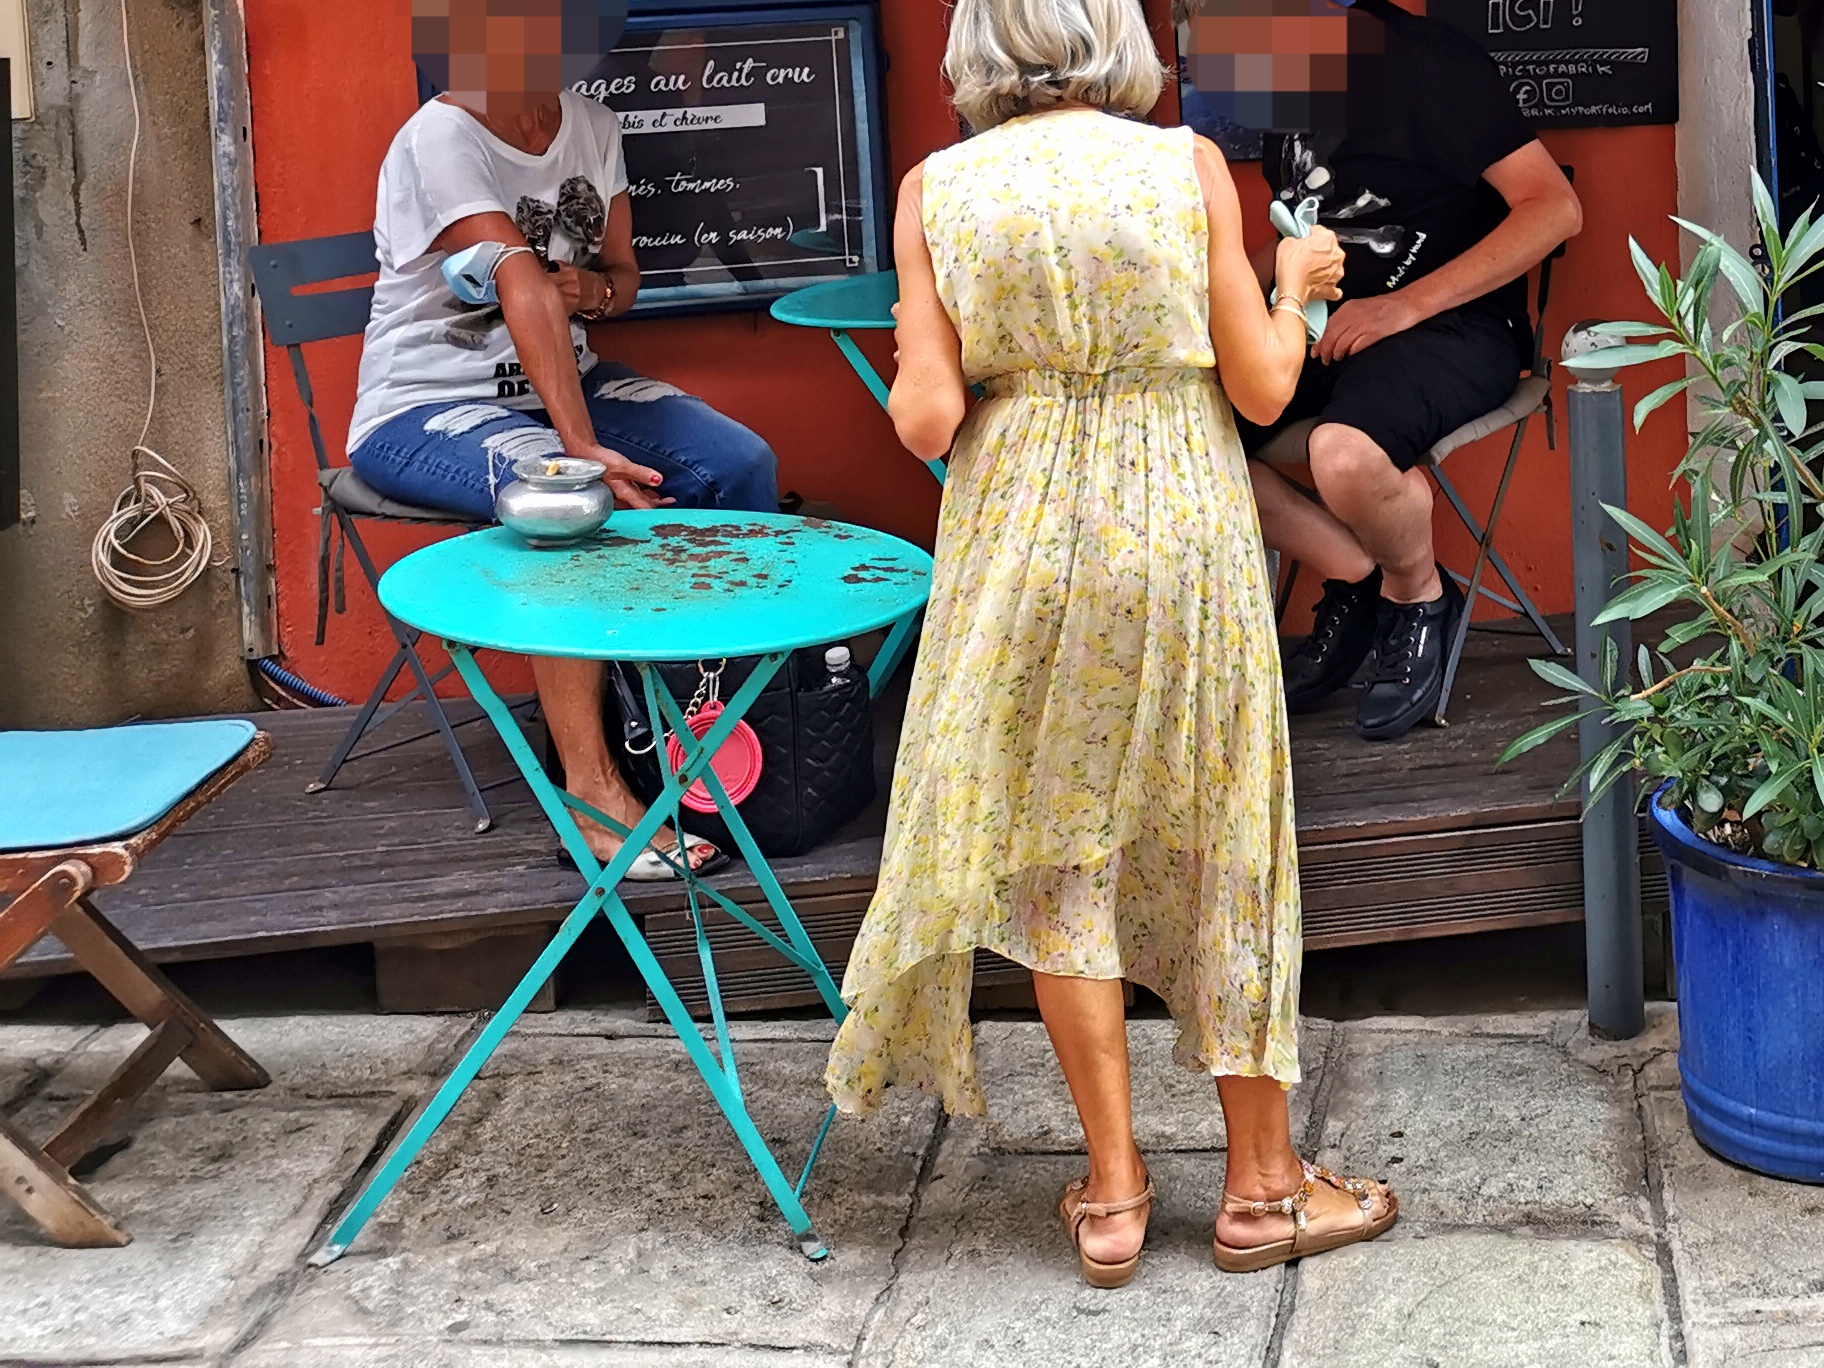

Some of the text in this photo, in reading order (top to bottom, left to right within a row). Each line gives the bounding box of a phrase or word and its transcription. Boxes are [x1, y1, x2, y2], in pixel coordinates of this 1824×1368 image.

[571, 57, 816, 103] ages au lait cru
[652, 112, 674, 128] et
[673, 110, 723, 127] chèvre
[694, 222, 720, 247] (en
[728, 216, 794, 246] saison)
